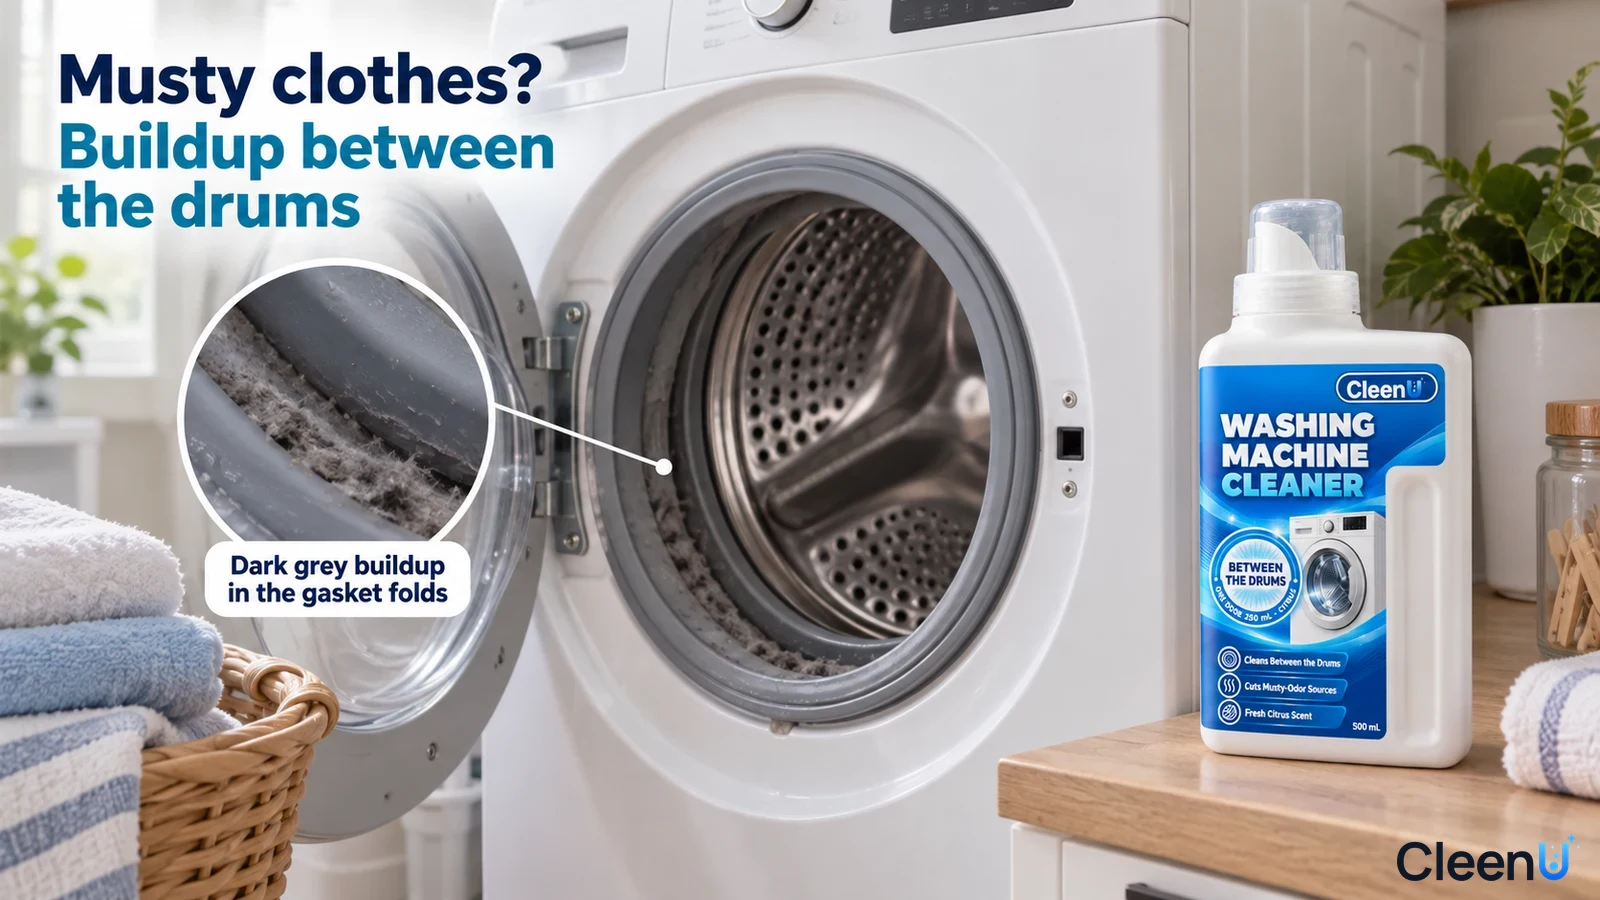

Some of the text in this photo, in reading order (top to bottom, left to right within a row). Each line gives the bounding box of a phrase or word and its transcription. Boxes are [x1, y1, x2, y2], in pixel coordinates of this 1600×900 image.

[1346, 380, 1423, 399] CleenU
[1220, 412, 1375, 438] WASHING
[1222, 443, 1369, 468] MACHINE
[1221, 472, 1364, 497] CLEANER
[1228, 562, 1283, 573] BETWEEN
[1225, 575, 1286, 586] THE DRUMS
[1244, 656, 1341, 668] Cleans Between the Drums
[1244, 682, 1337, 694] Cuts Musty-Odor Sources
[1245, 708, 1313, 720] Fresh Citrus Scent
[1352, 722, 1381, 731] 500 mL
